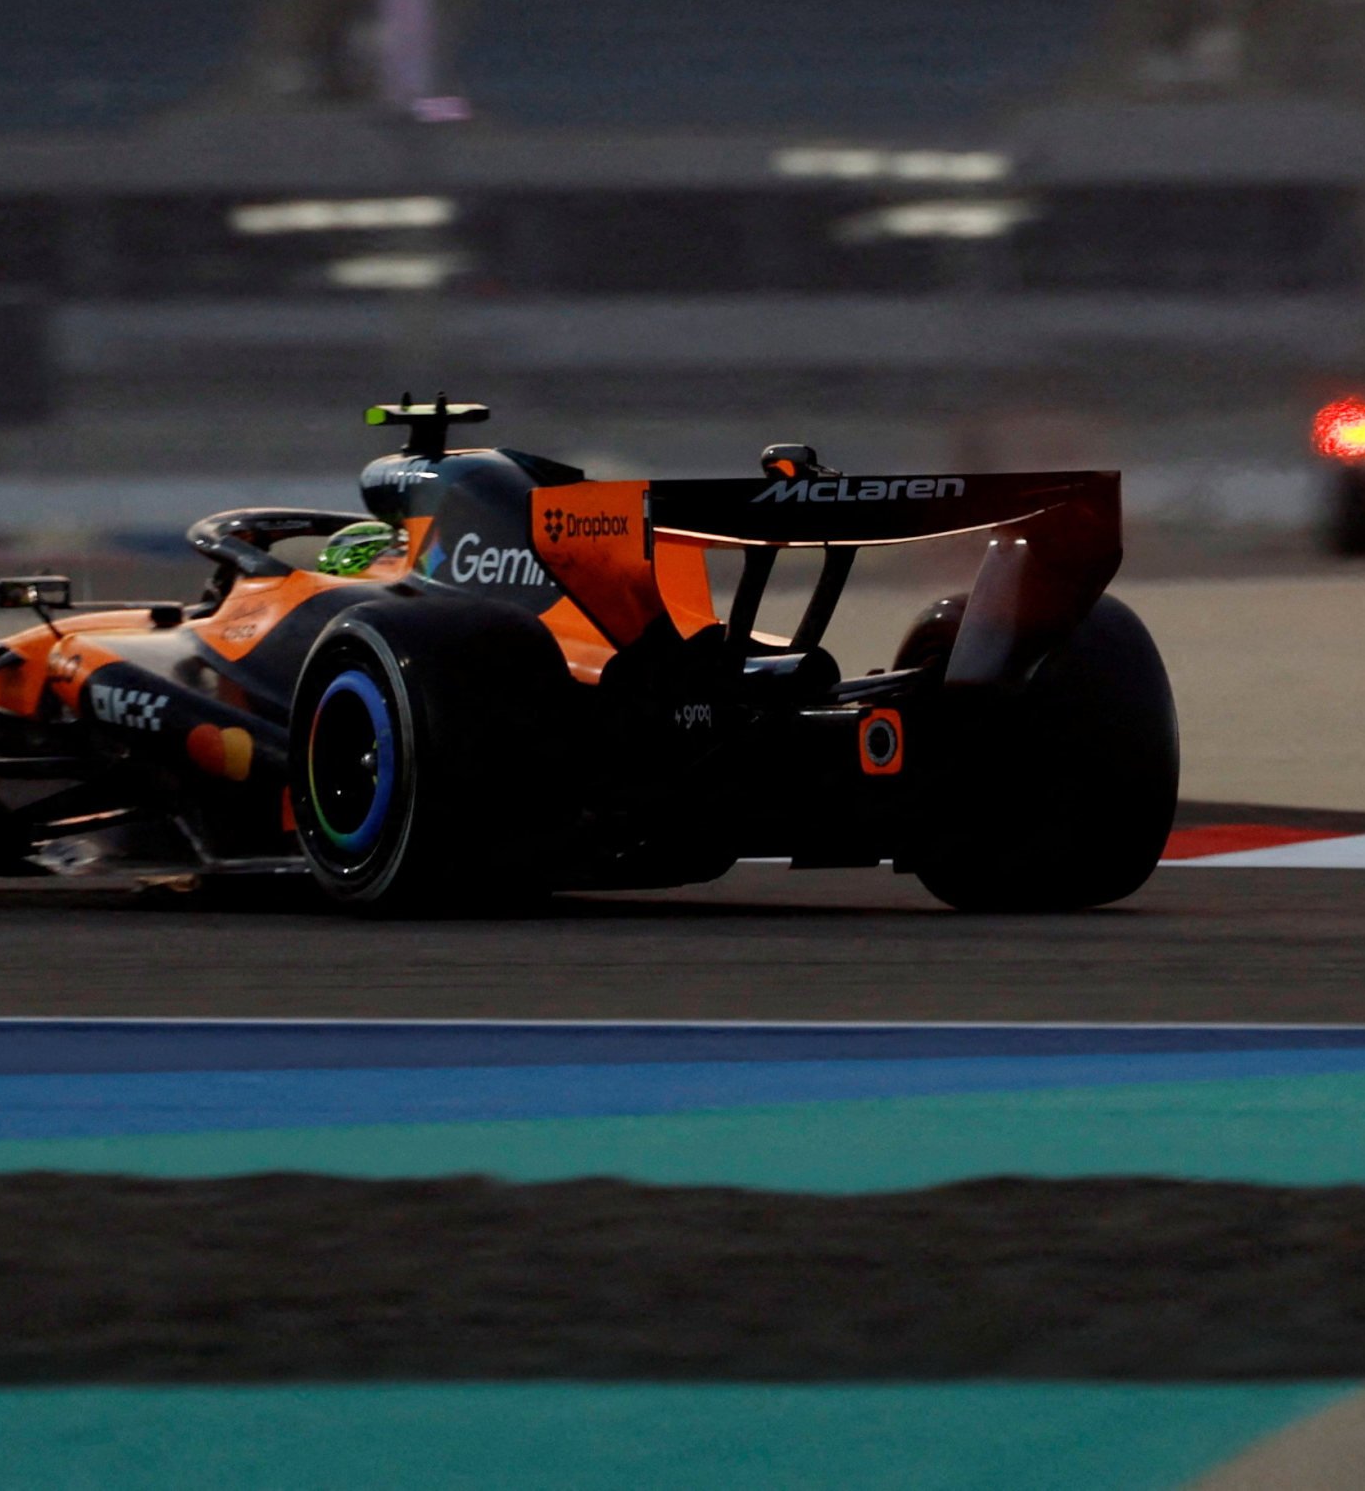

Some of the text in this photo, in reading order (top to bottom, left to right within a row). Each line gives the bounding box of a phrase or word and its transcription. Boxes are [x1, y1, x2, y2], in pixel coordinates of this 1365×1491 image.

[750, 478, 965, 502] McLaren
[567, 511, 628, 542] Dropbox
[91, 684, 169, 731] OKX
[683, 704, 711, 729] groq
